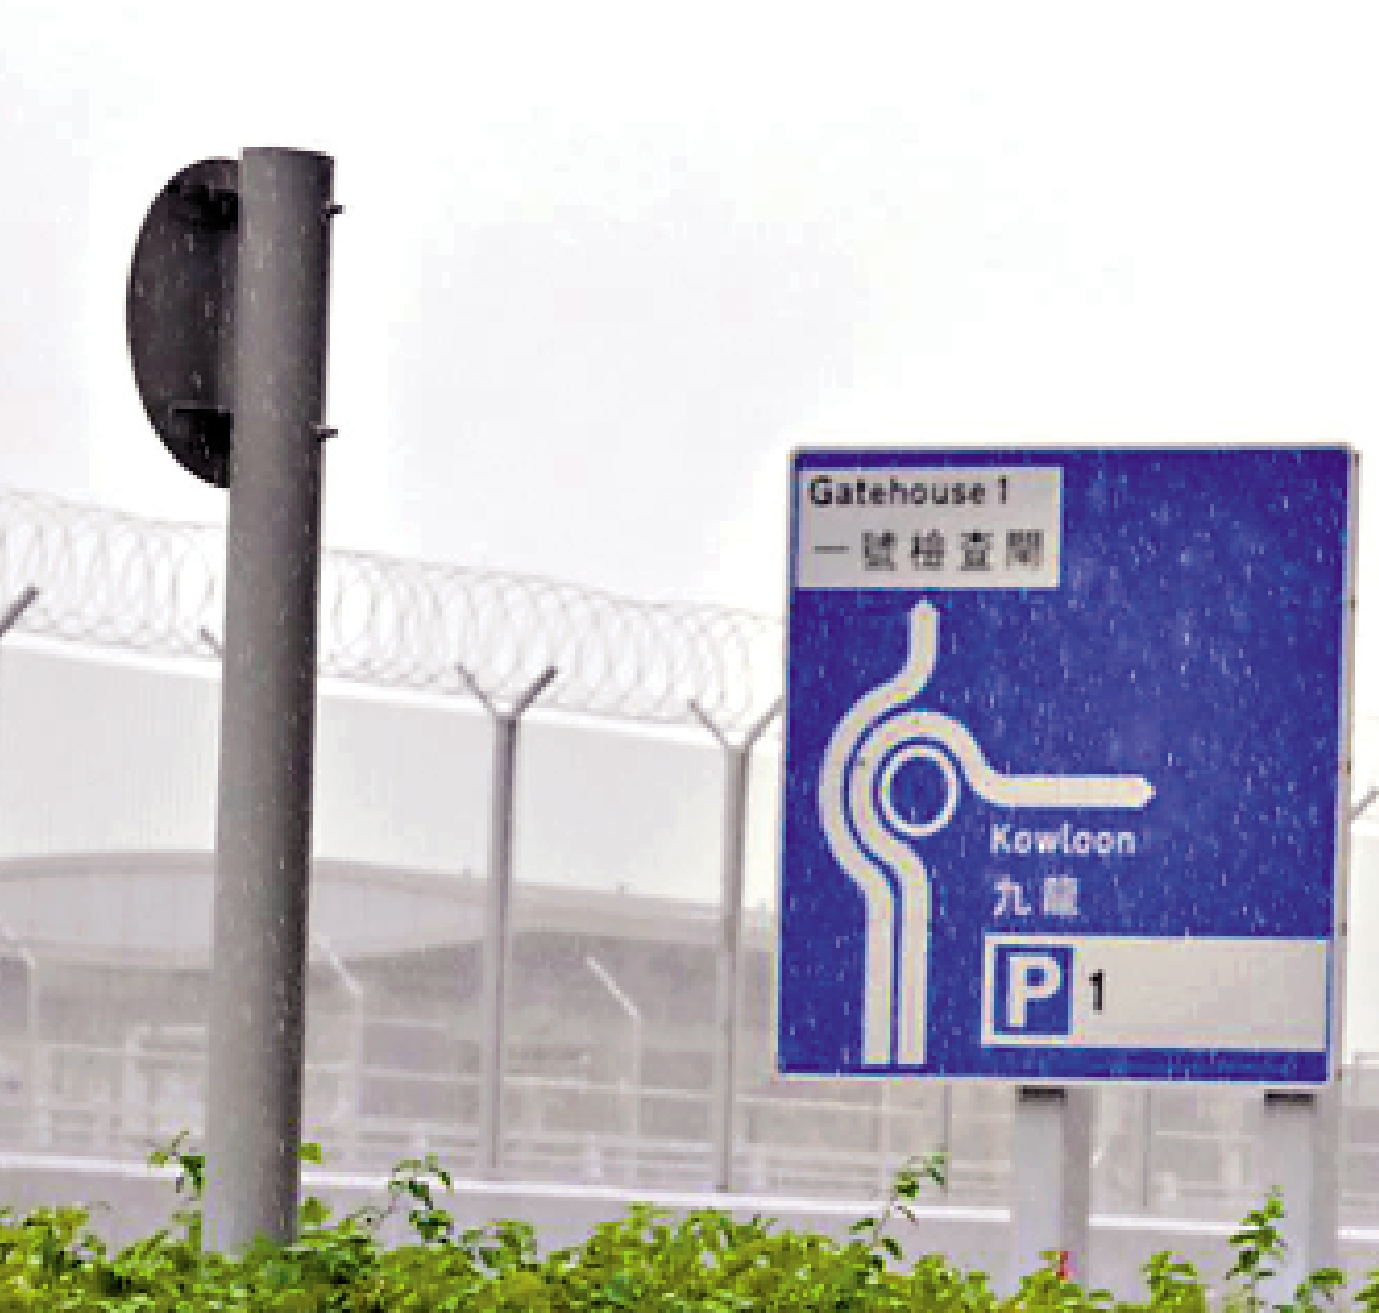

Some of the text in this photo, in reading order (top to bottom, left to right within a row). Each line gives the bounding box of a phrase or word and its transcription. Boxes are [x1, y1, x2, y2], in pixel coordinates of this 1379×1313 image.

[808, 476, 1010, 506] Gatehouse 1
[990, 824, 1137, 855] Kowloon
[1006, 955, 1106, 1028] P 1
